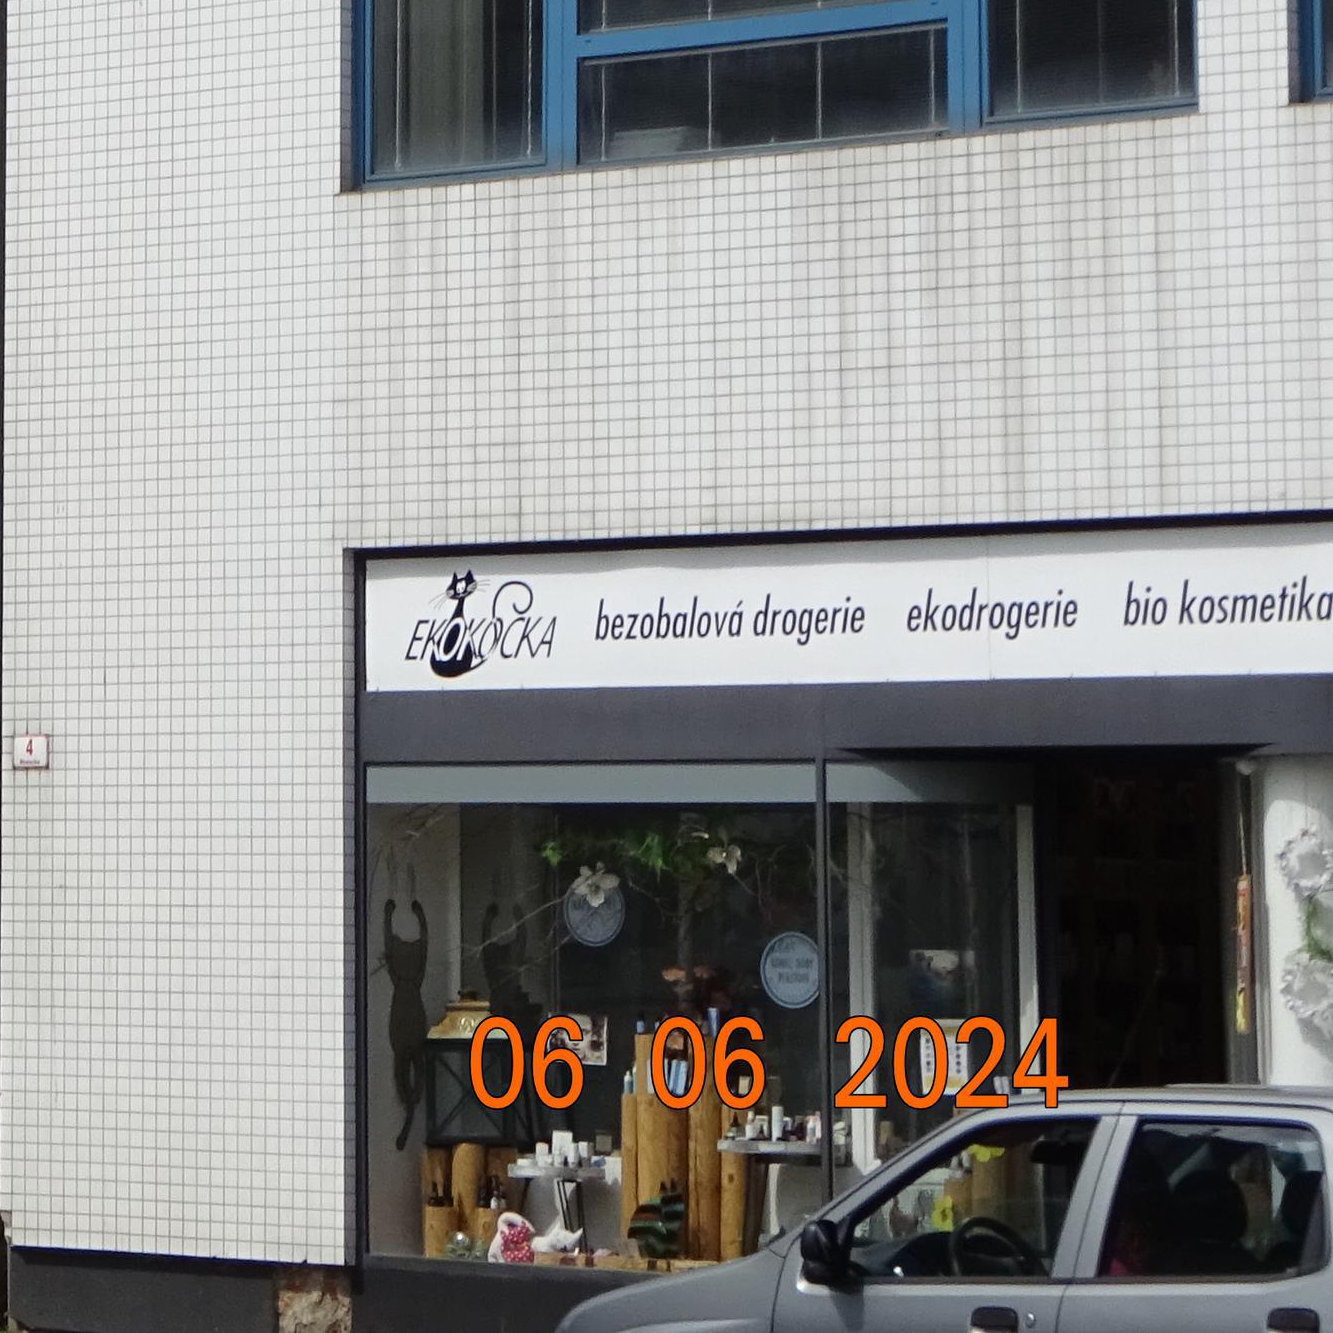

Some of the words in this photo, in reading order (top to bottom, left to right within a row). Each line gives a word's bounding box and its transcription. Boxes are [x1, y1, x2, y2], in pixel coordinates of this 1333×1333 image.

[594, 598, 743, 642] bezobalová
[753, 594, 866, 647] drogerie
[906, 587, 1079, 641] ekodrogerie
[1123, 581, 1168, 626] bio
[1178, 575, 1333, 626] kosmetika
[25, 738, 33, 756] 4
